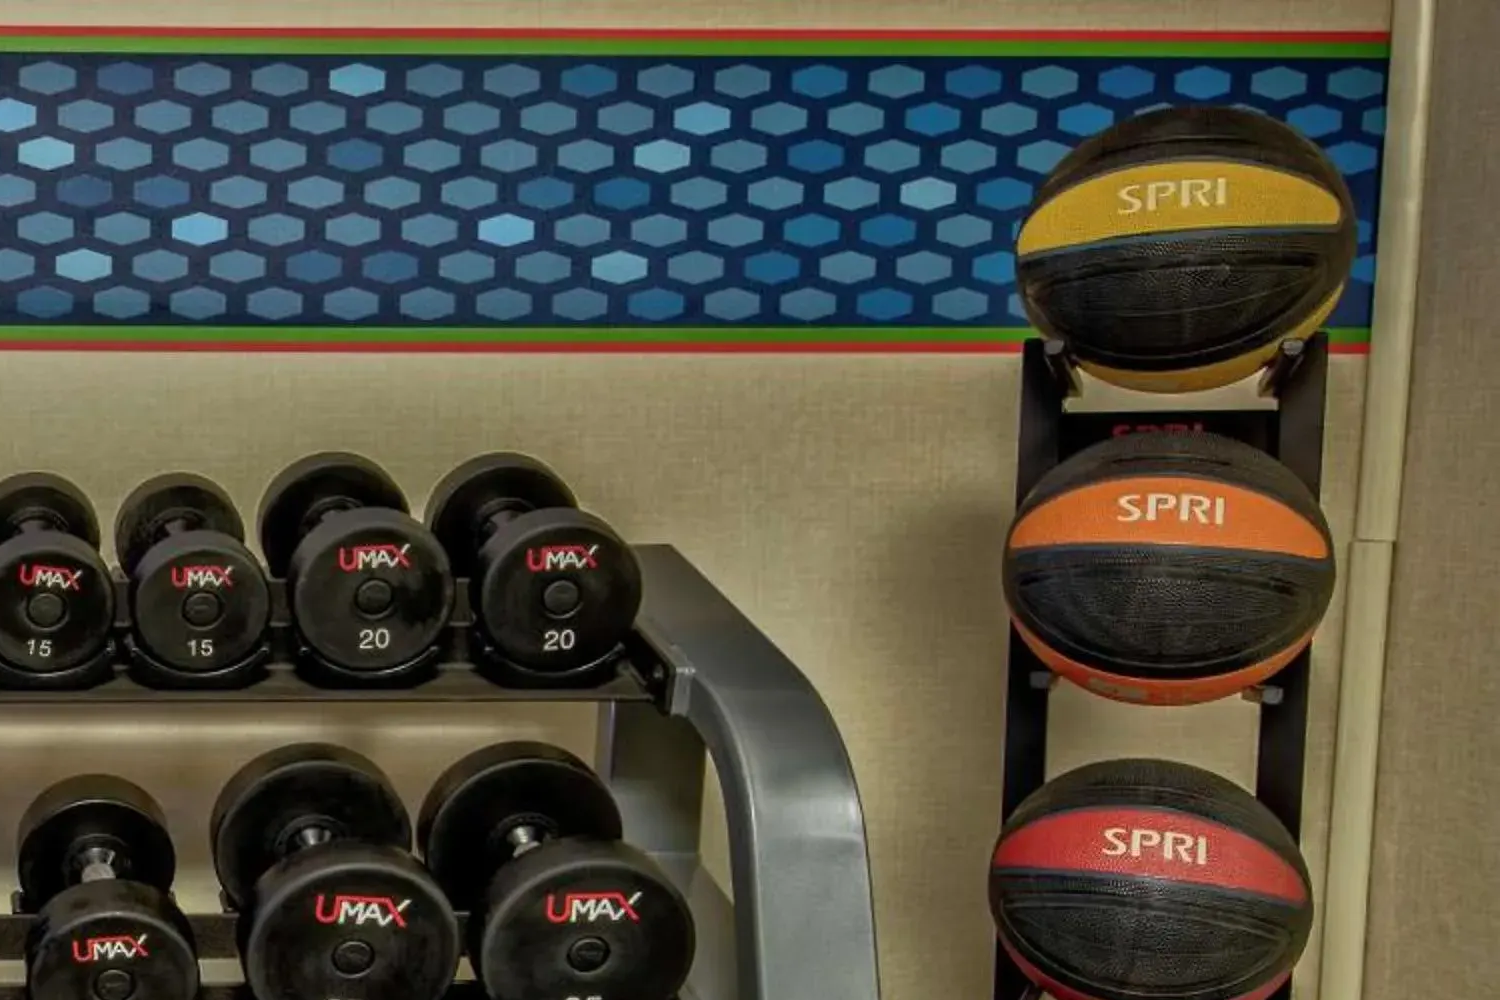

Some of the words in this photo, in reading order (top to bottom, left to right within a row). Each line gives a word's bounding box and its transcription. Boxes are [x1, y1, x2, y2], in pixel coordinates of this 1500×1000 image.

[1117, 177, 1227, 215] SPRI
[1116, 493, 1225, 526] SPRI
[338, 543, 410, 572] UMAX
[526, 545, 598, 572] UMAX
[19, 564, 82, 589] UMAX
[171, 565, 233, 588] UMAX
[27, 639, 52, 657] 15
[188, 639, 213, 657] 15
[359, 628, 390, 649] 20
[543, 629, 575, 651] 20
[1101, 827, 1207, 865] SPRI
[315, 894, 411, 928] UMAX
[545, 891, 642, 923] UMAX
[72, 933, 148, 962] UMAX
